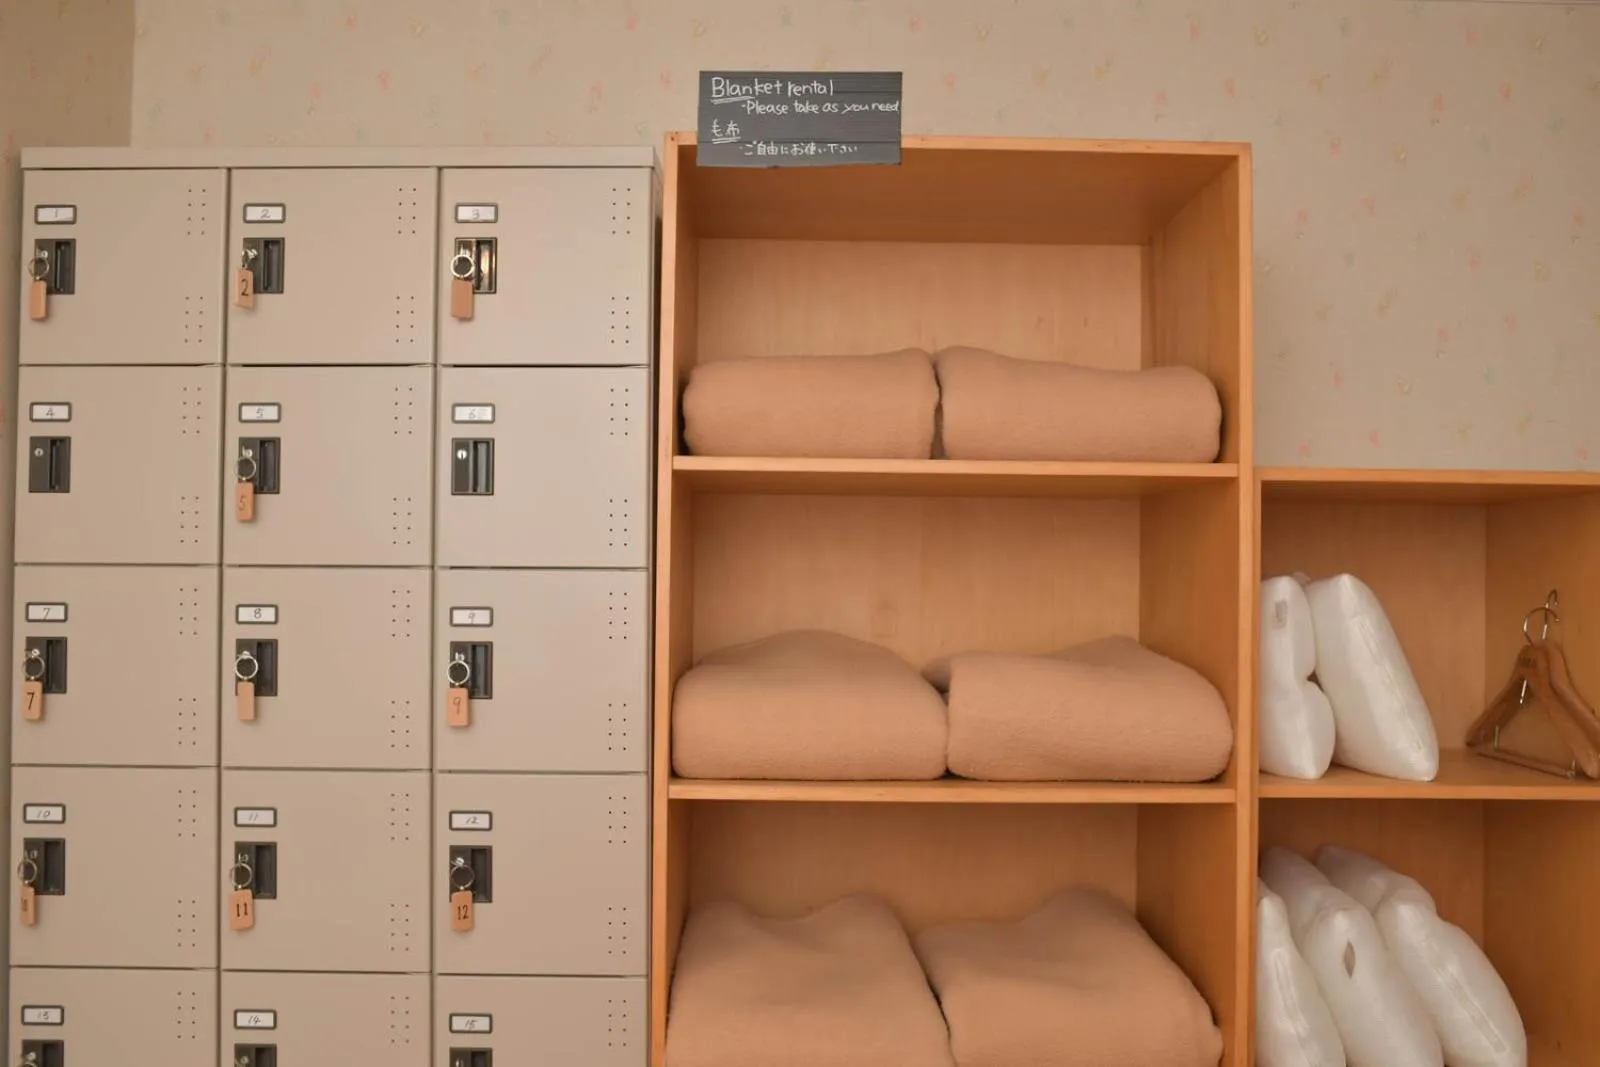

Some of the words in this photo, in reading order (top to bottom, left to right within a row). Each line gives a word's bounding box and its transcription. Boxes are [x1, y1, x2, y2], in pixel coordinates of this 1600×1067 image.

[711, 77, 782, 98] Blanket
[788, 79, 834, 98] rental
[794, 102, 819, 114] take
[822, 103, 839, 113] as
[841, 103, 870, 115] you
[872, 100, 900, 114] need
[260, 208, 270, 219] 2
[471, 208, 480, 220] 3
[241, 278, 249, 297] 2
[45, 407, 55, 417] 4
[239, 495, 247, 511] 5
[43, 607, 50, 622] 7
[253, 607, 261, 619] 8
[467, 612, 475, 624] 9
[27, 692, 35, 710] 7
[453, 696, 462, 715] 9
[37, 809, 51, 819] 10
[465, 815, 478, 825] 12
[236, 899, 248, 918] 11
[457, 904, 469, 921] 12
[248, 1014, 261, 1025] 14
[464, 1019, 476, 1030] 15
